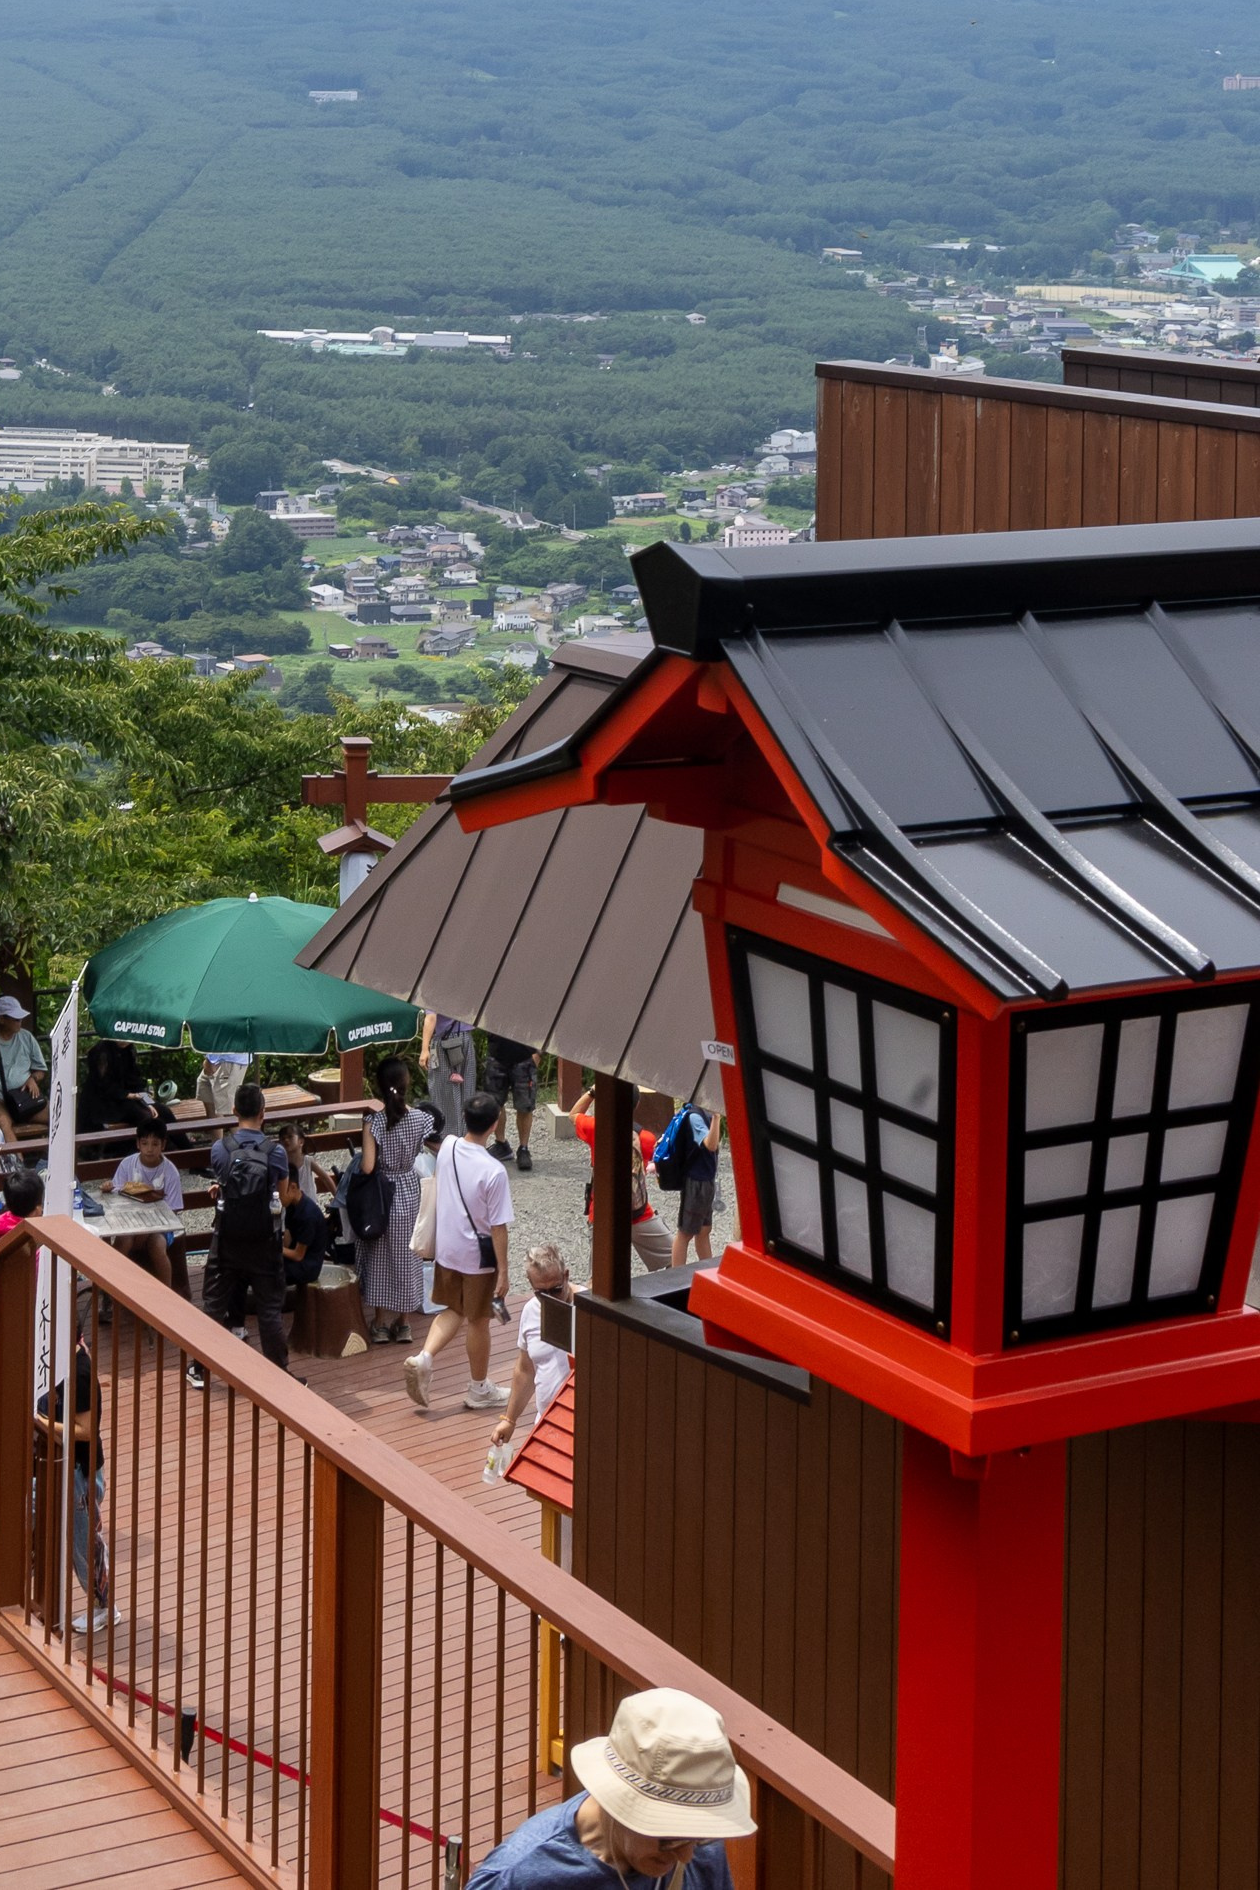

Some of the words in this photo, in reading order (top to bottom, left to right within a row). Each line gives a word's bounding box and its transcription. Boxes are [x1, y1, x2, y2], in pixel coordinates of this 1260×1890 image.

[114, 1021, 147, 1034] CAPTAIN
[147, 1025, 166, 1037] STAG
[348, 1025, 375, 1041] CAPTAIN
[375, 1021, 392, 1034] STAG
[707, 1043, 734, 1058] OPEN
